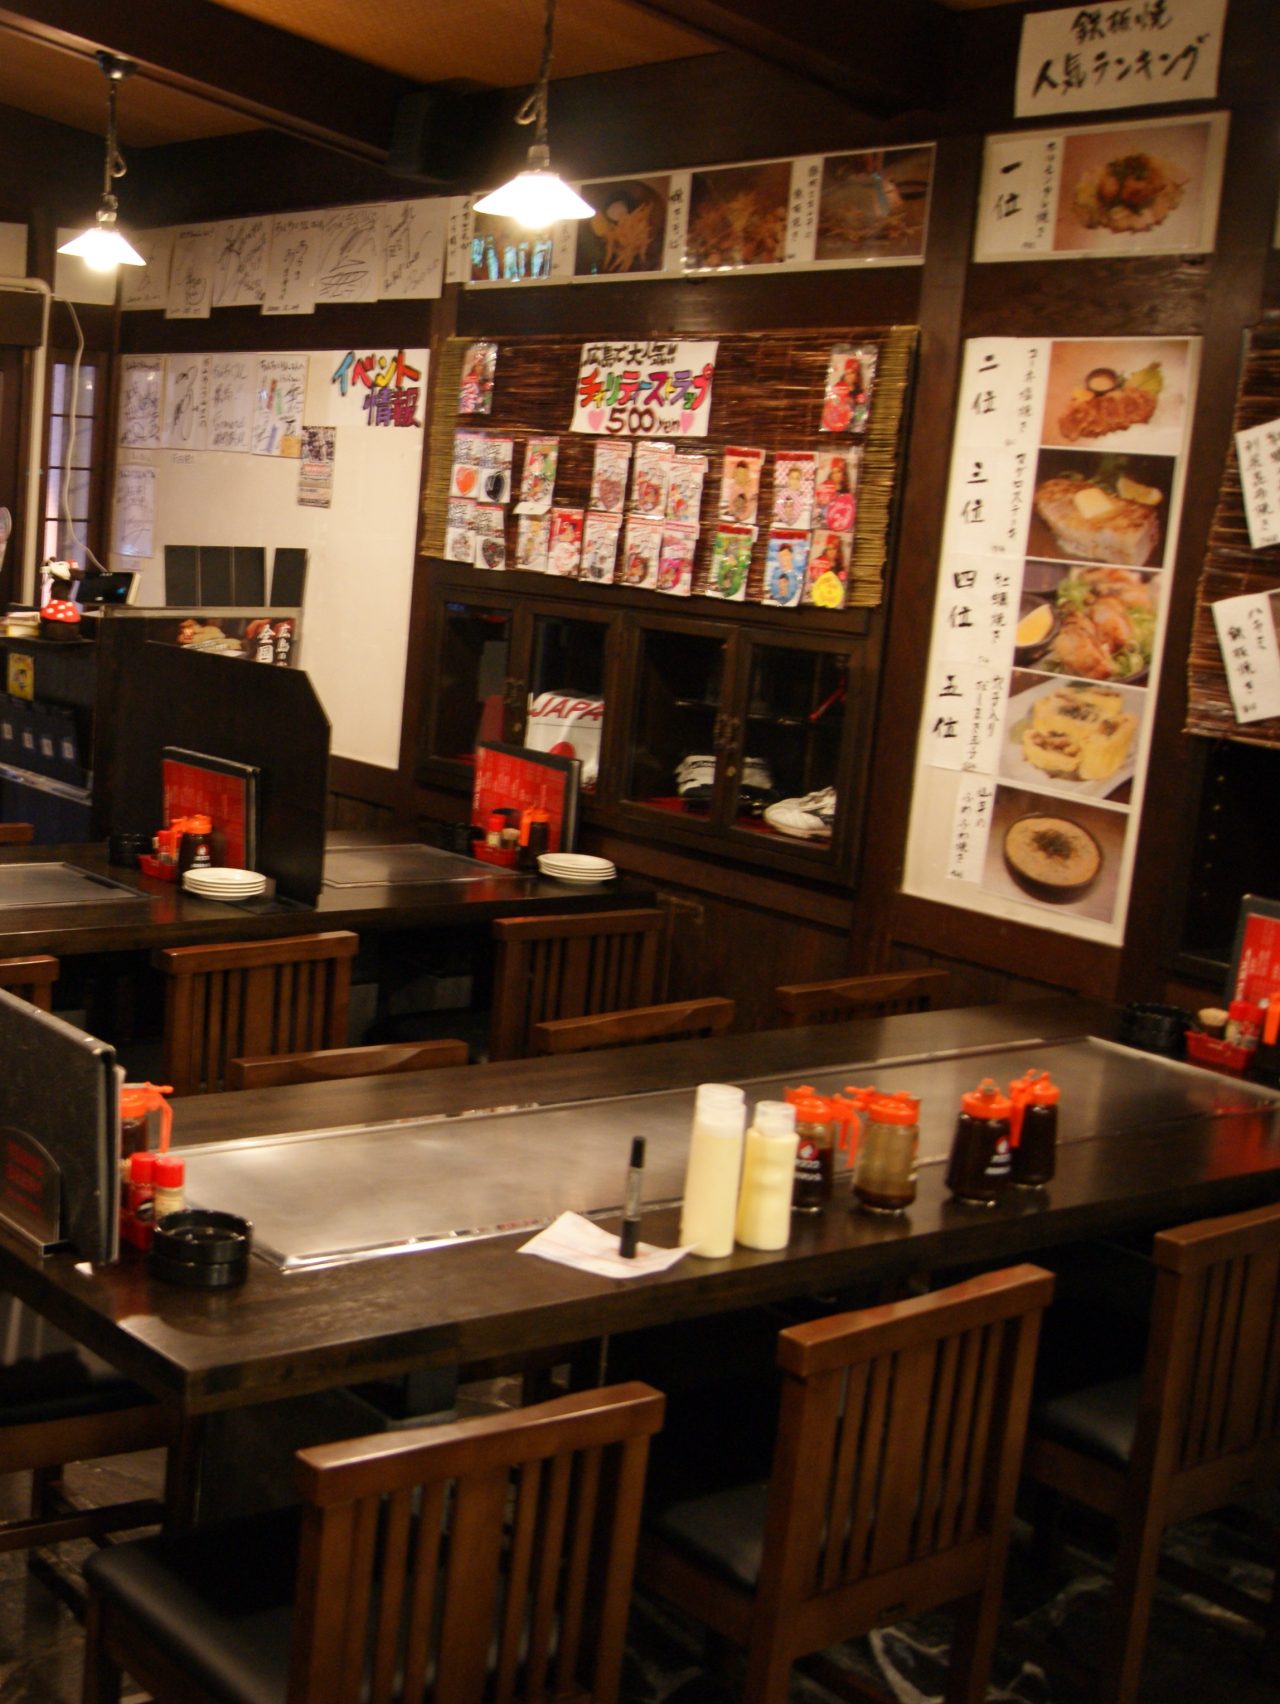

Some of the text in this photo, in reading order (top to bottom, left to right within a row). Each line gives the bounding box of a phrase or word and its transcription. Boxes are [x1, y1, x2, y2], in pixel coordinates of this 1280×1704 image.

[1032, 33, 1210, 98] 人気ランキング
[994, 161, 1022, 220] 一位
[332, 350, 422, 396] イベント
[972, 354, 1000, 415] 二位
[362, 386, 421, 427] 情報
[960, 461, 989, 523] 三位
[949, 570, 977, 628] 四位
[932, 675, 963, 738] 五位
